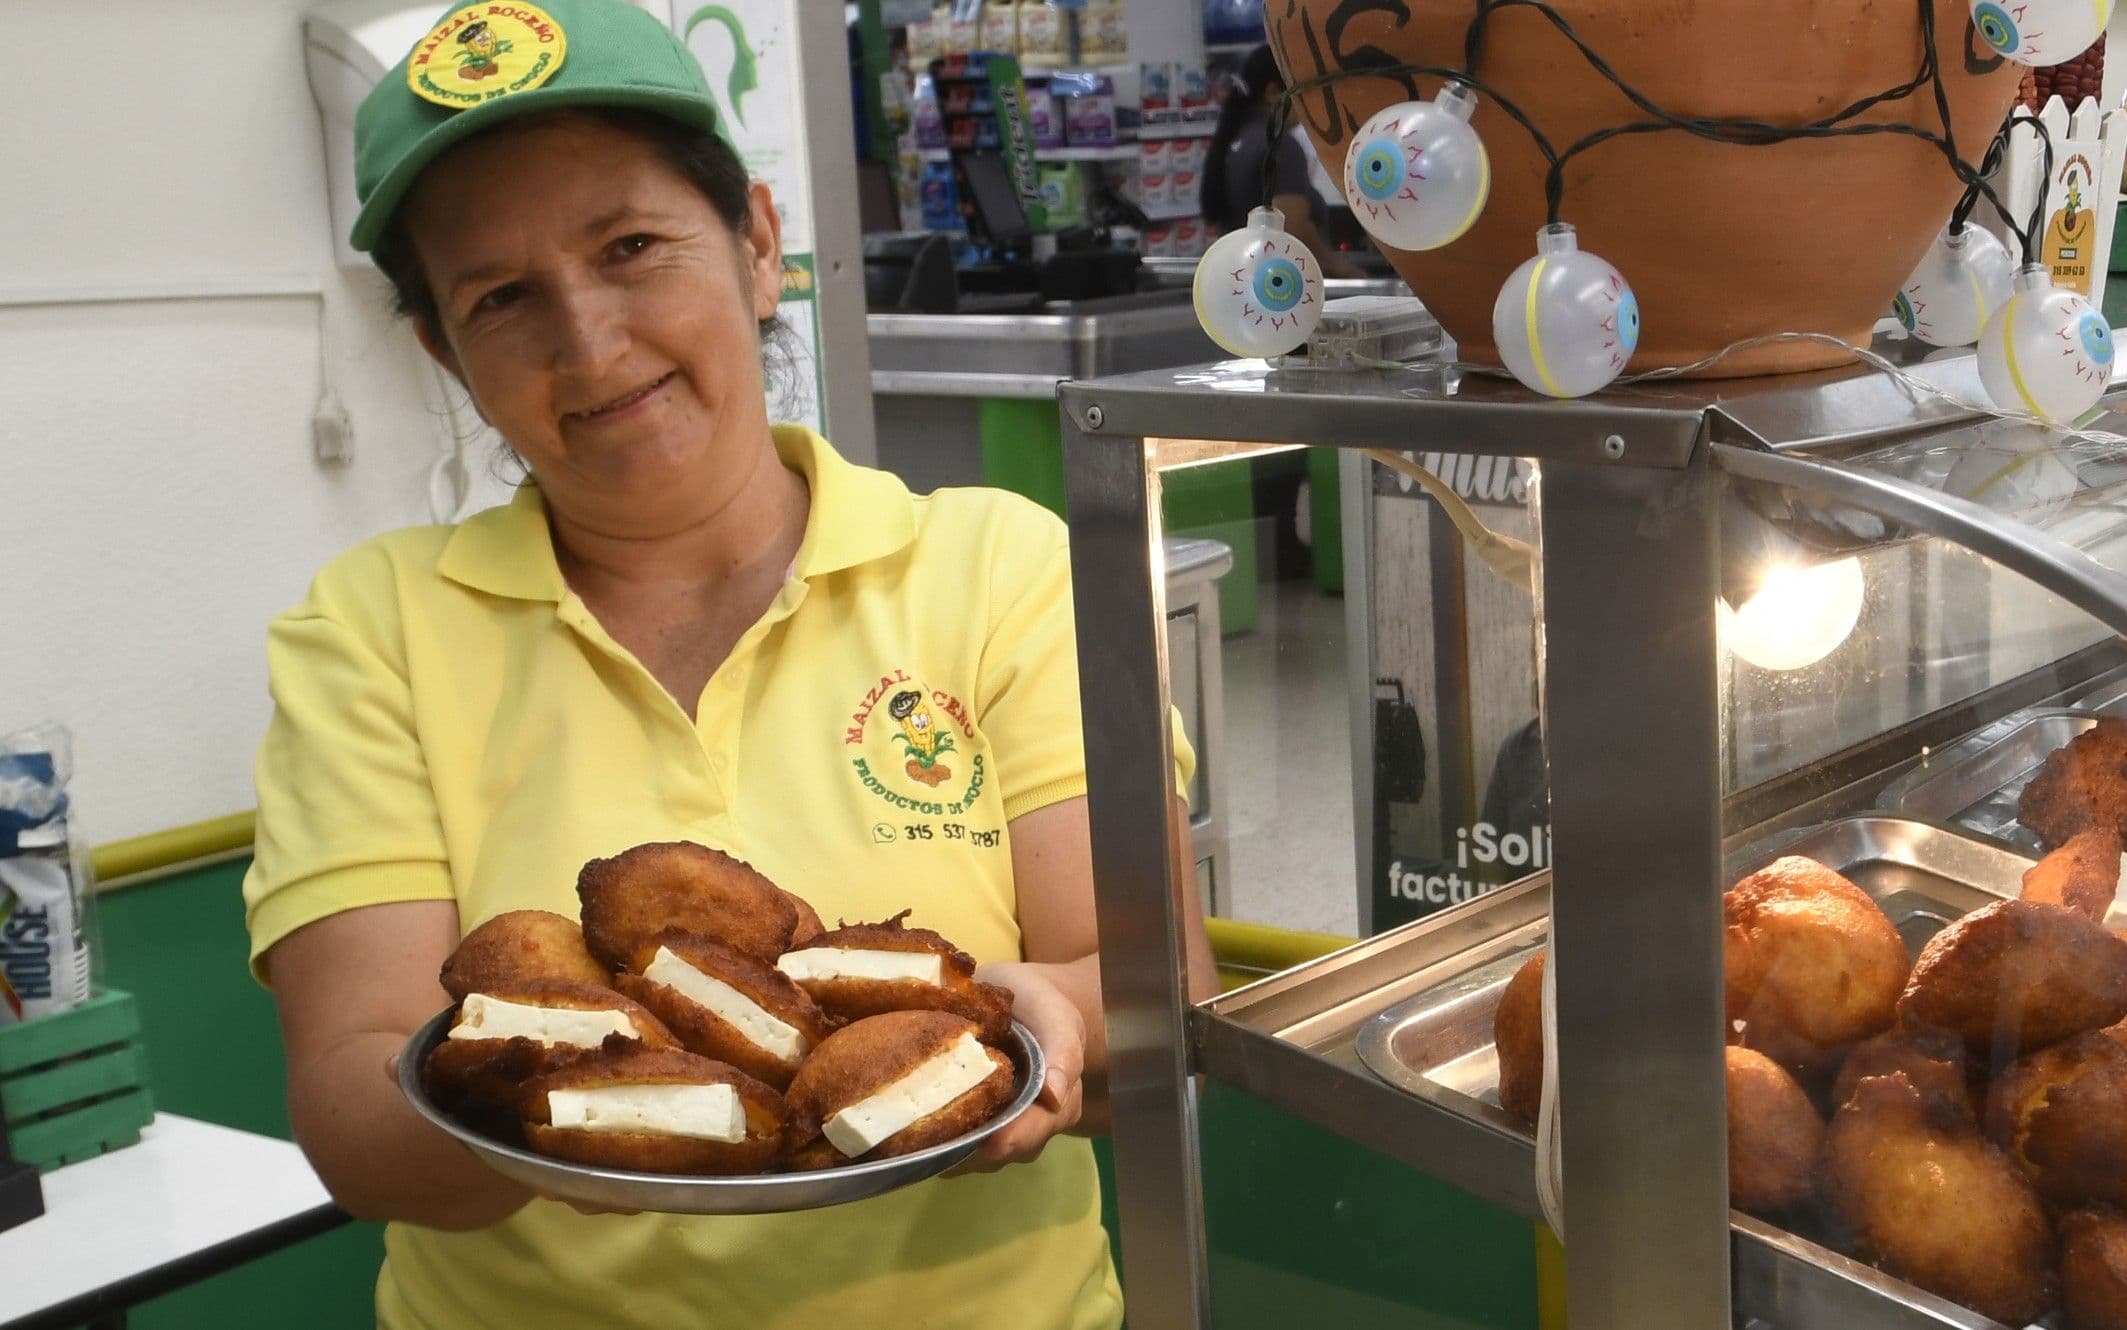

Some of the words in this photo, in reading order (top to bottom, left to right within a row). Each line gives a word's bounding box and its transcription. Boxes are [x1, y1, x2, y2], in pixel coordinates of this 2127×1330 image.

[415, 11, 480, 66] MAIZAL
[845, 669, 912, 745] MAIZAL
[853, 757, 944, 815] PRODUCTOS
[904, 824, 934, 841] 315
[942, 823, 966, 840] 537
[1388, 861, 1503, 905] factu
[4, 903, 52, 1000] HOUSE
